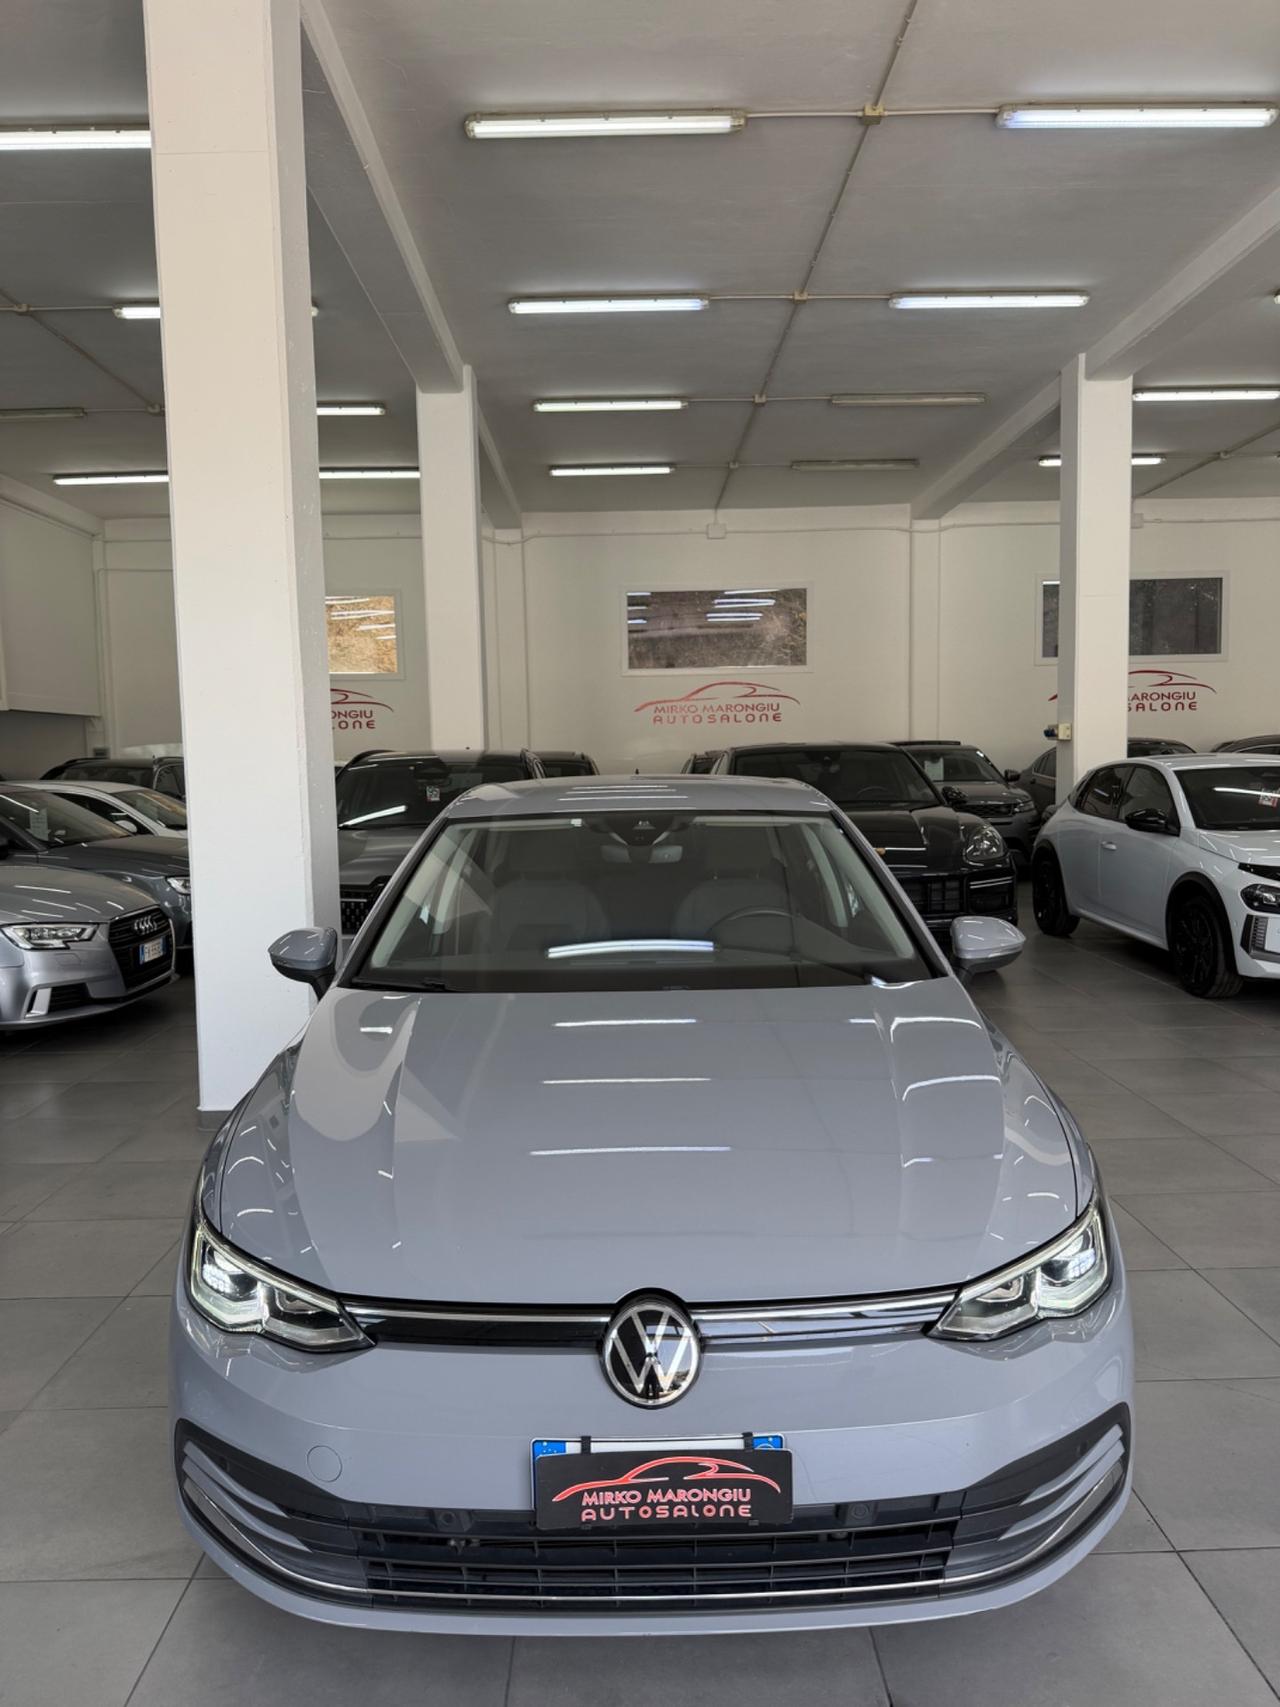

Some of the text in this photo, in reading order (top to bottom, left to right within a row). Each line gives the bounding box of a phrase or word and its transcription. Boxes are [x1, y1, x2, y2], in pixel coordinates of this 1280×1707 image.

[1128, 691, 1196, 702] ARONGIU
[653, 702, 781, 714] MIRKO MARONGIU
[652, 712, 783, 725] AUTOSALONE
[580, 1488, 752, 1506] MIRKO MARONGIU
[580, 1504, 752, 1522] AUTOSALONE
